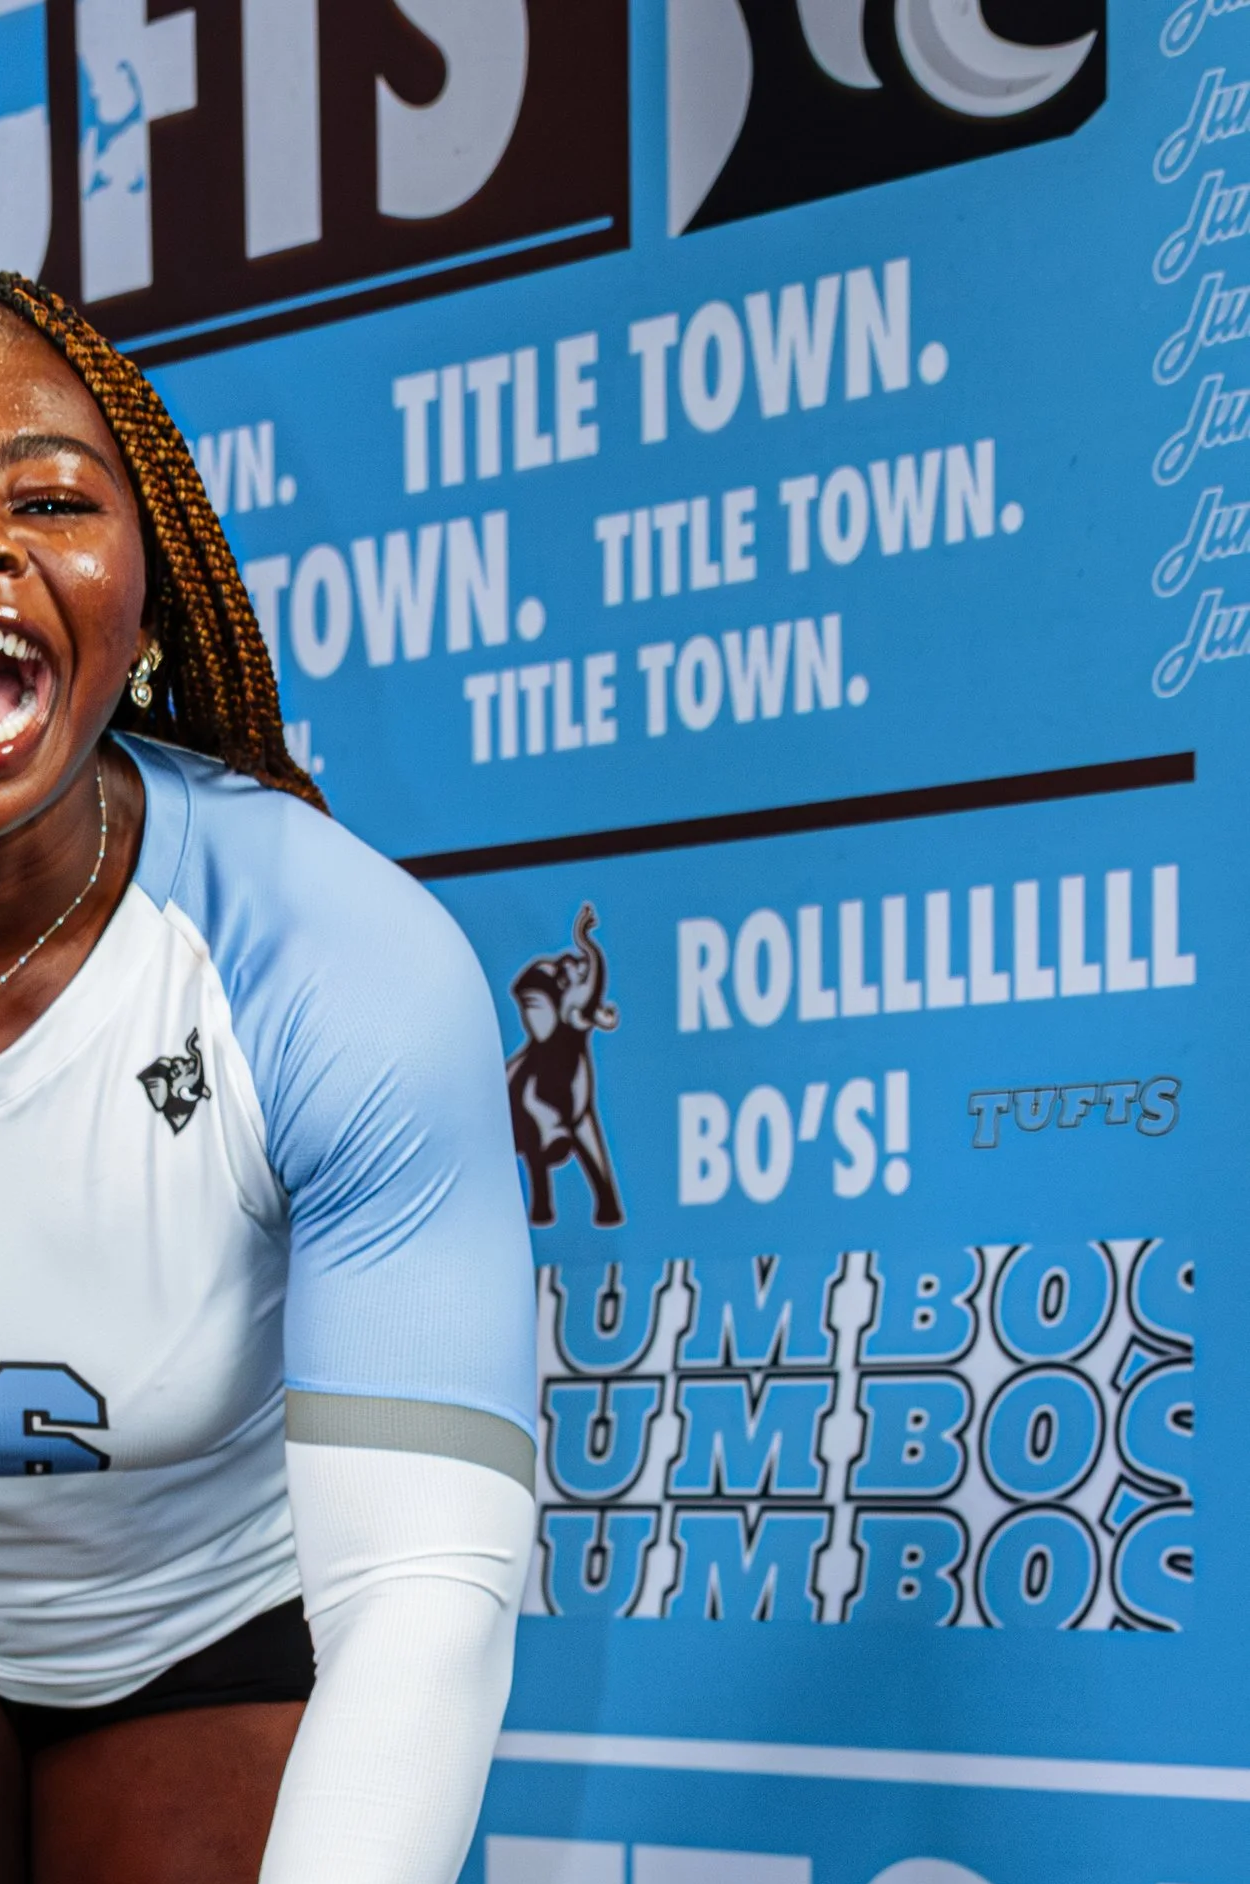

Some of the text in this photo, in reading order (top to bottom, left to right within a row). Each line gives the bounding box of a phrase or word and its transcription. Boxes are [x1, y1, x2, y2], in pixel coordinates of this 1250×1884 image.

[393, 257, 949, 494] TITLE TOWN.
[187, 420, 297, 519] WN.
[594, 438, 1024, 607] TITLE TOWN.
[244, 510, 546, 680] TOWN.
[464, 651, 618, 765] TITLE
[637, 613, 869, 737] TOWN.
[678, 863, 1196, 1034] ROLLLLLLLLL
[678, 1069, 912, 1206] BO'S!
[967, 1075, 1182, 1150] TUFTS
